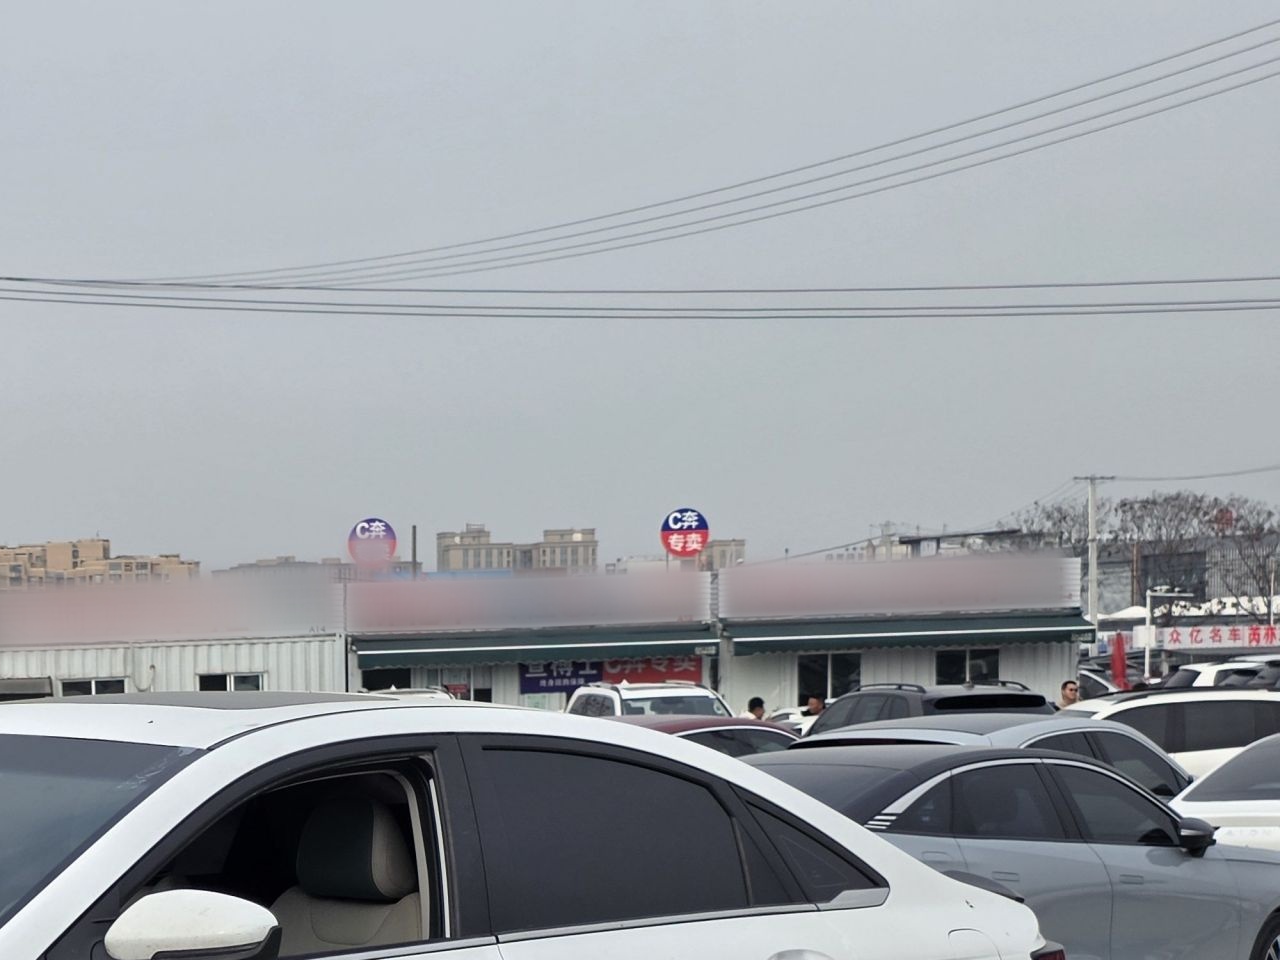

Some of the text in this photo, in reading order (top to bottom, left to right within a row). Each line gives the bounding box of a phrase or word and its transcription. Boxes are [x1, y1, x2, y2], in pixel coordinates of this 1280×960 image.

[668, 510, 699, 529] C奔
[355, 520, 386, 539] C奔
[668, 532, 702, 552] 专卖
[1168, 626, 1241, 643] 众亿名车
